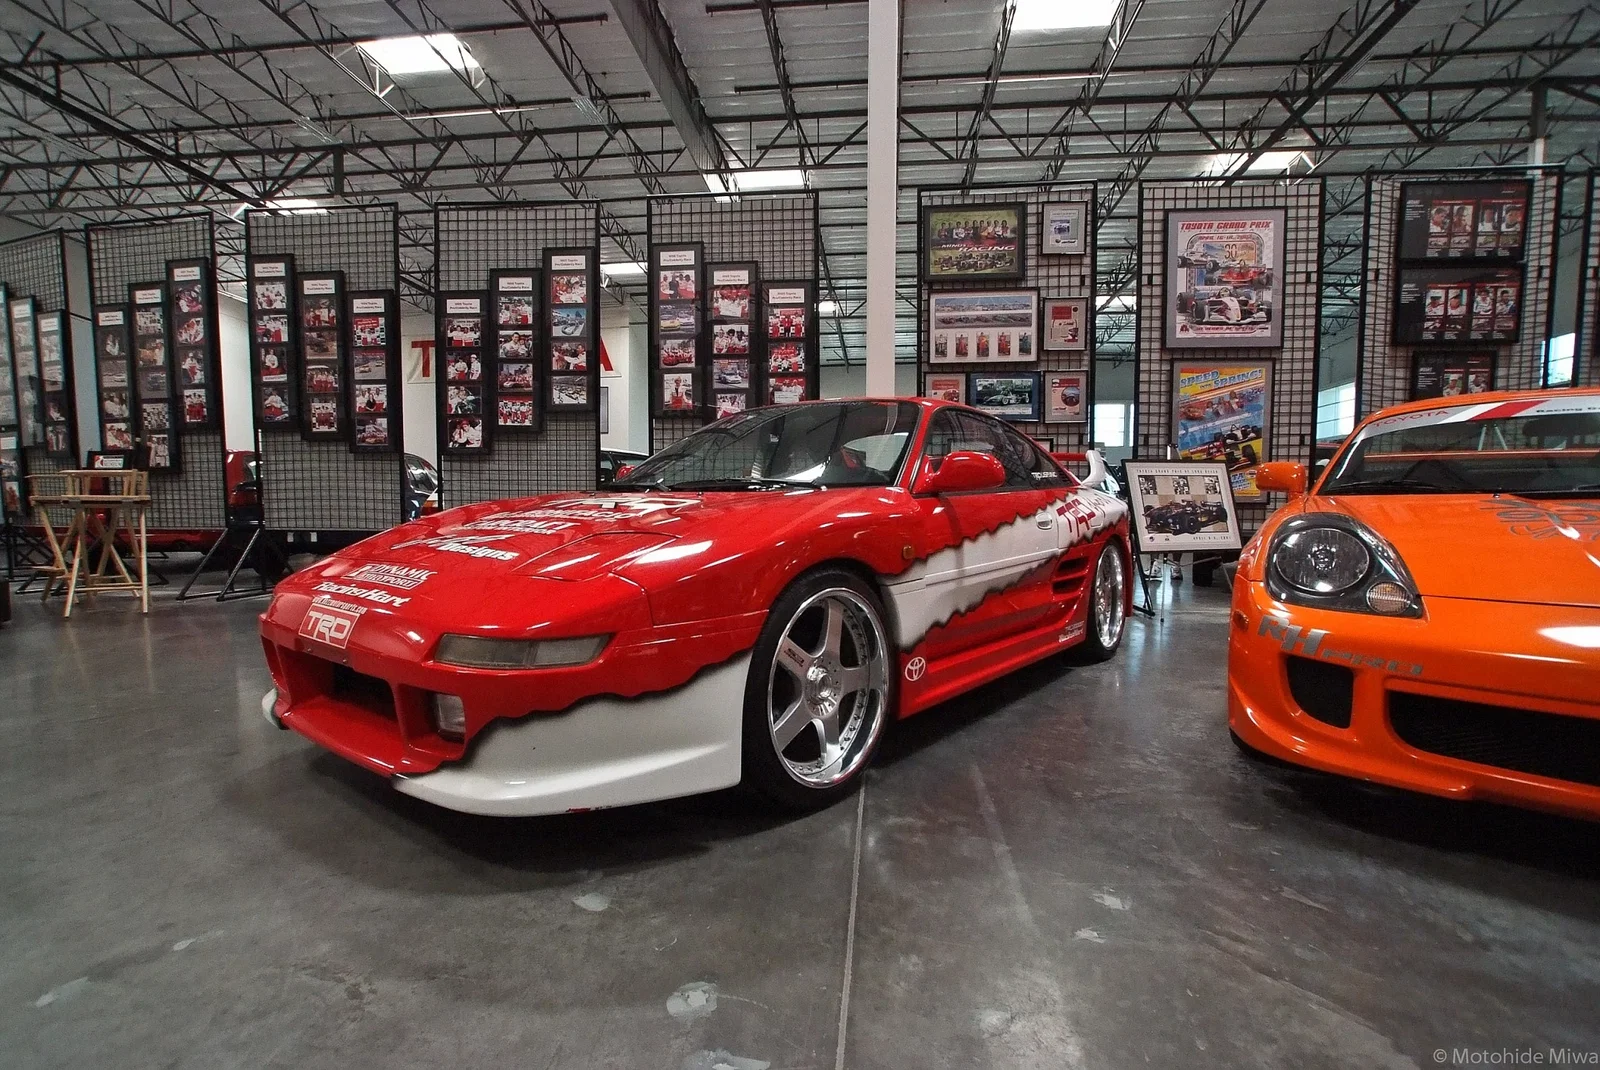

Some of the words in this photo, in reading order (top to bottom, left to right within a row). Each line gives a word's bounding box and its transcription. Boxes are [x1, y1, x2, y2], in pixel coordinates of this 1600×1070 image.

[1180, 222, 1214, 230] TOYOTA
[1216, 221, 1247, 229] GRAND
[1224, 243, 1238, 260] 30
[1180, 370, 1220, 388] SPEED
[1213, 368, 1262, 388] SPRING!
[1373, 410, 1448, 427] TOYOTA
[1056, 498, 1097, 538] TRD
[436, 541, 520, 561] Designs
[372, 563, 438, 580] DYNAMIC
[308, 610, 351, 643] TRD
